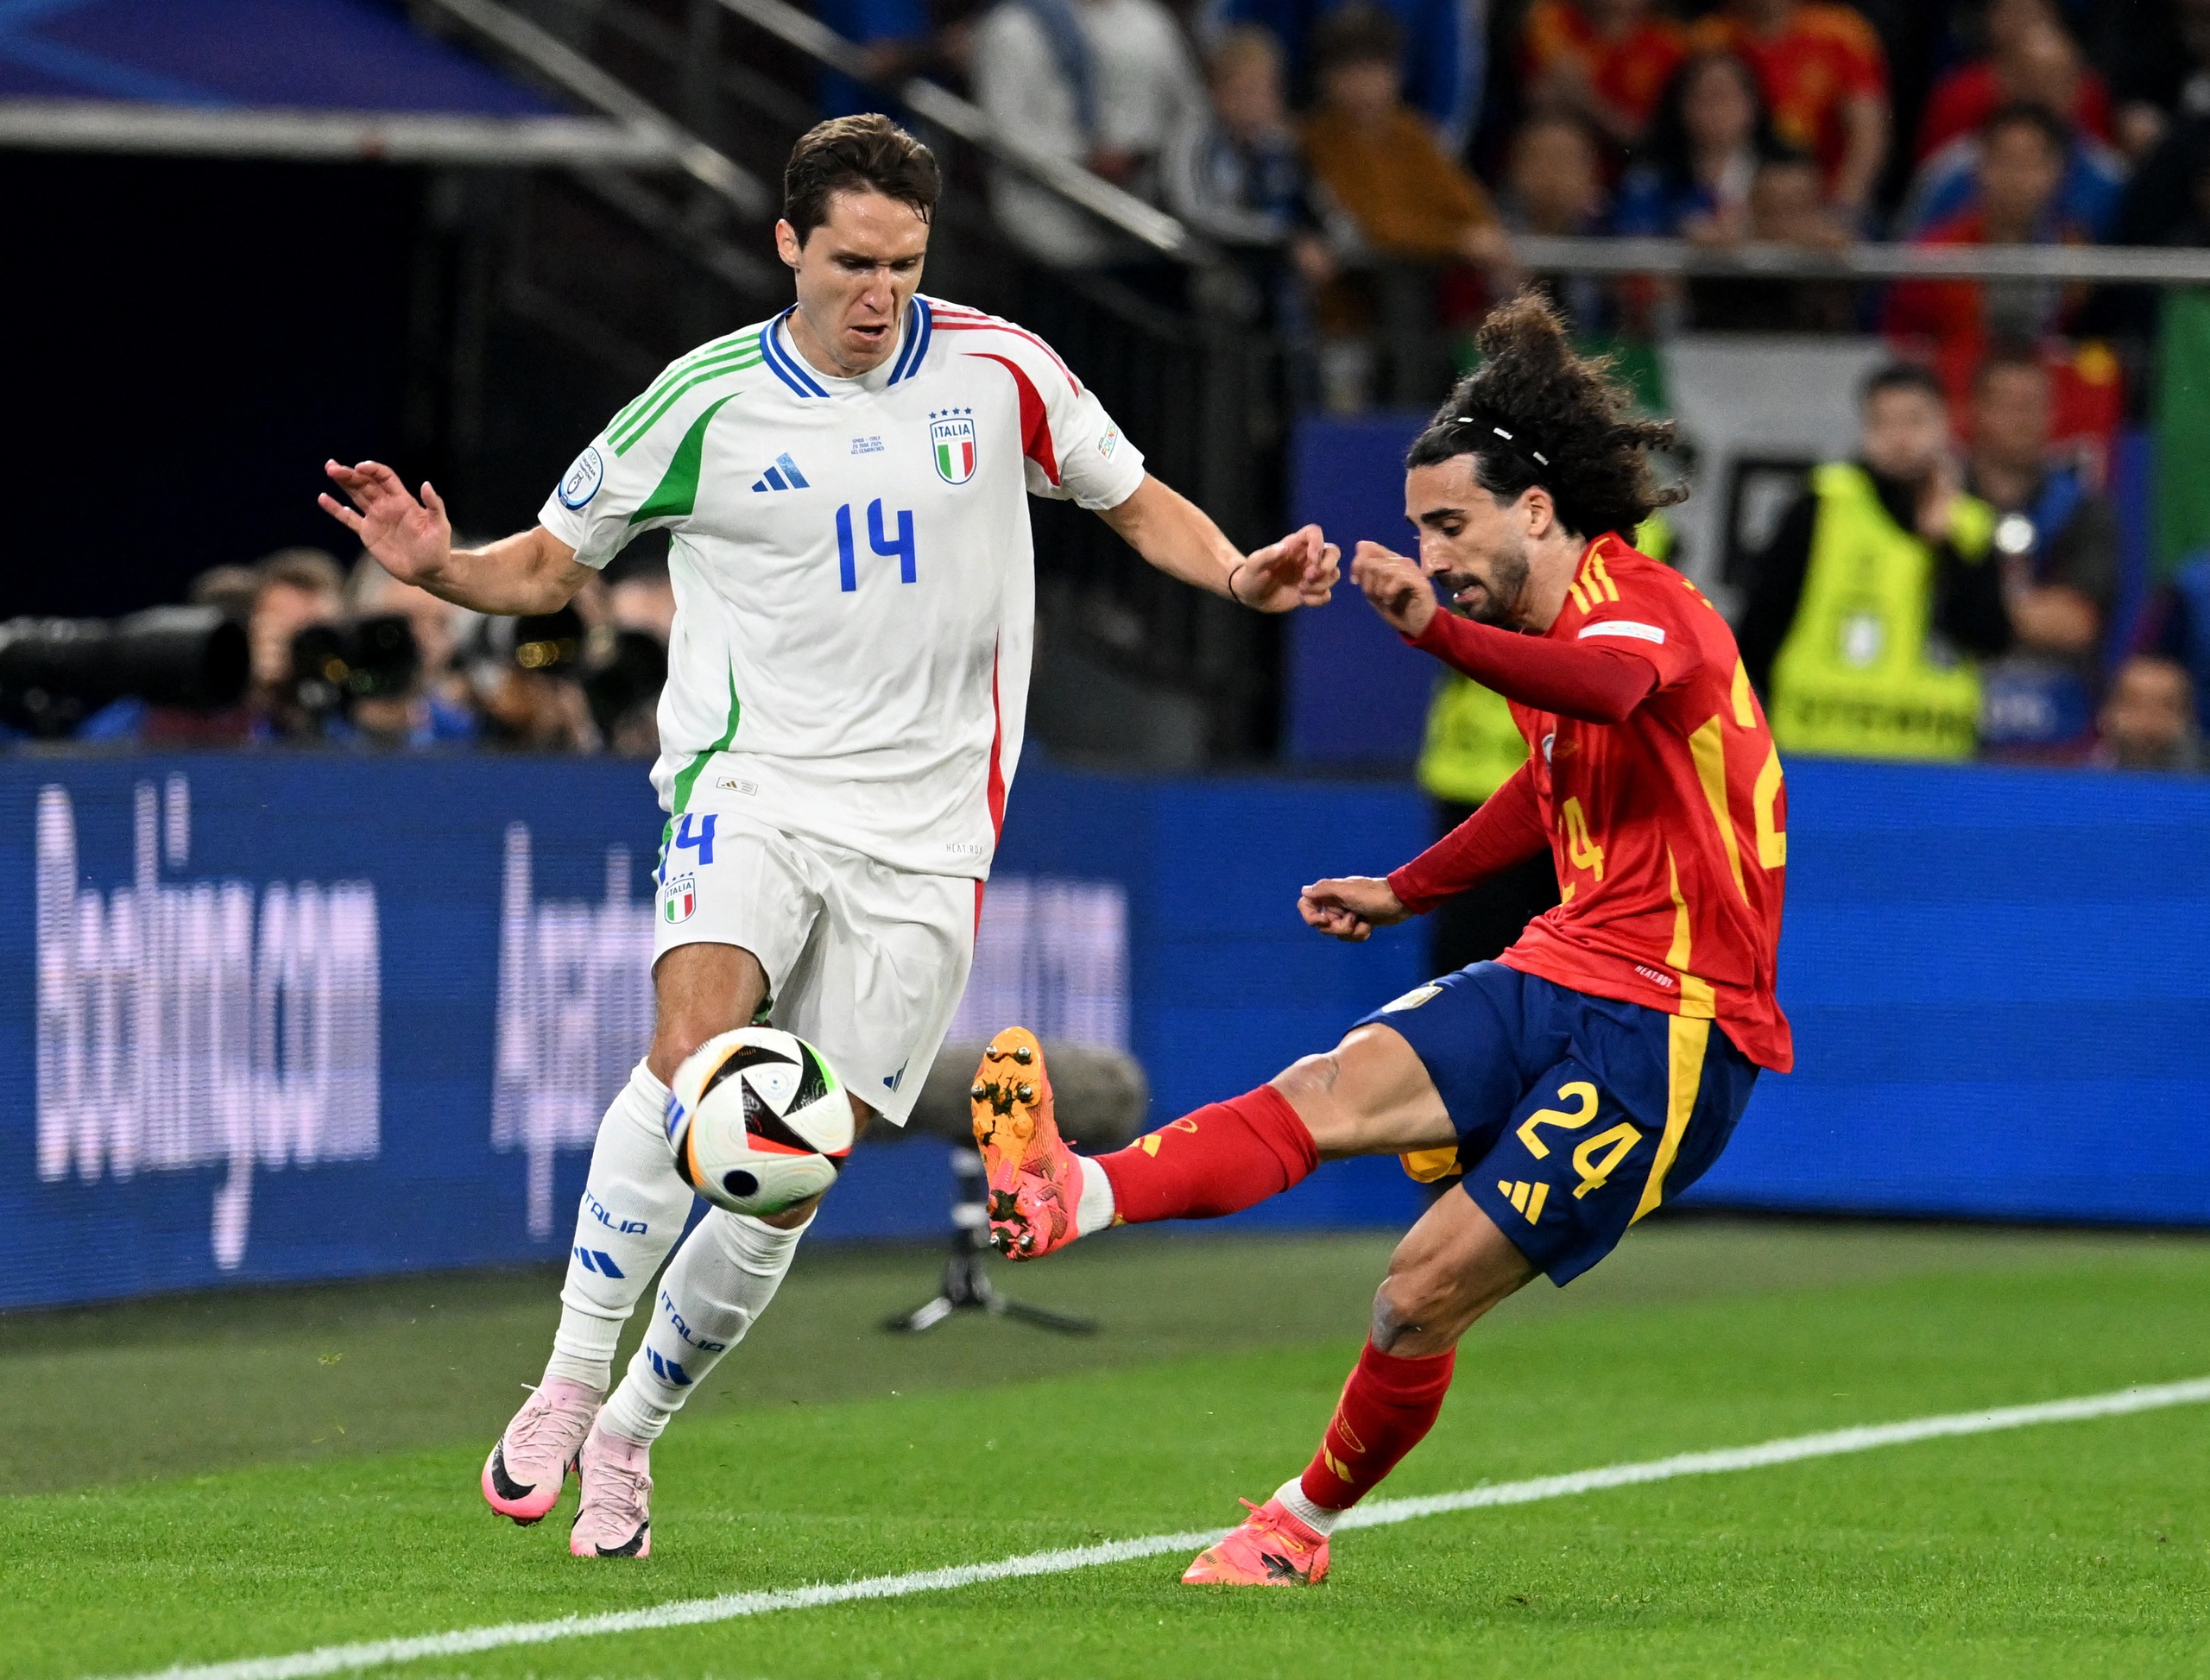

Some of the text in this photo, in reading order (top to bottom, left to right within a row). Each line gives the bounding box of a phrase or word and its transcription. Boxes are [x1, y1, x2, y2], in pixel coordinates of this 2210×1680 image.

[934, 423, 971, 439] ITALIA
[835, 497, 917, 592] 14
[1558, 795, 1605, 906] 4
[666, 881, 691, 898] ITALIA
[1516, 1081, 1643, 1200] 24
[585, 1187, 648, 1235] TALIA
[660, 1290, 727, 1353] ITALIA
